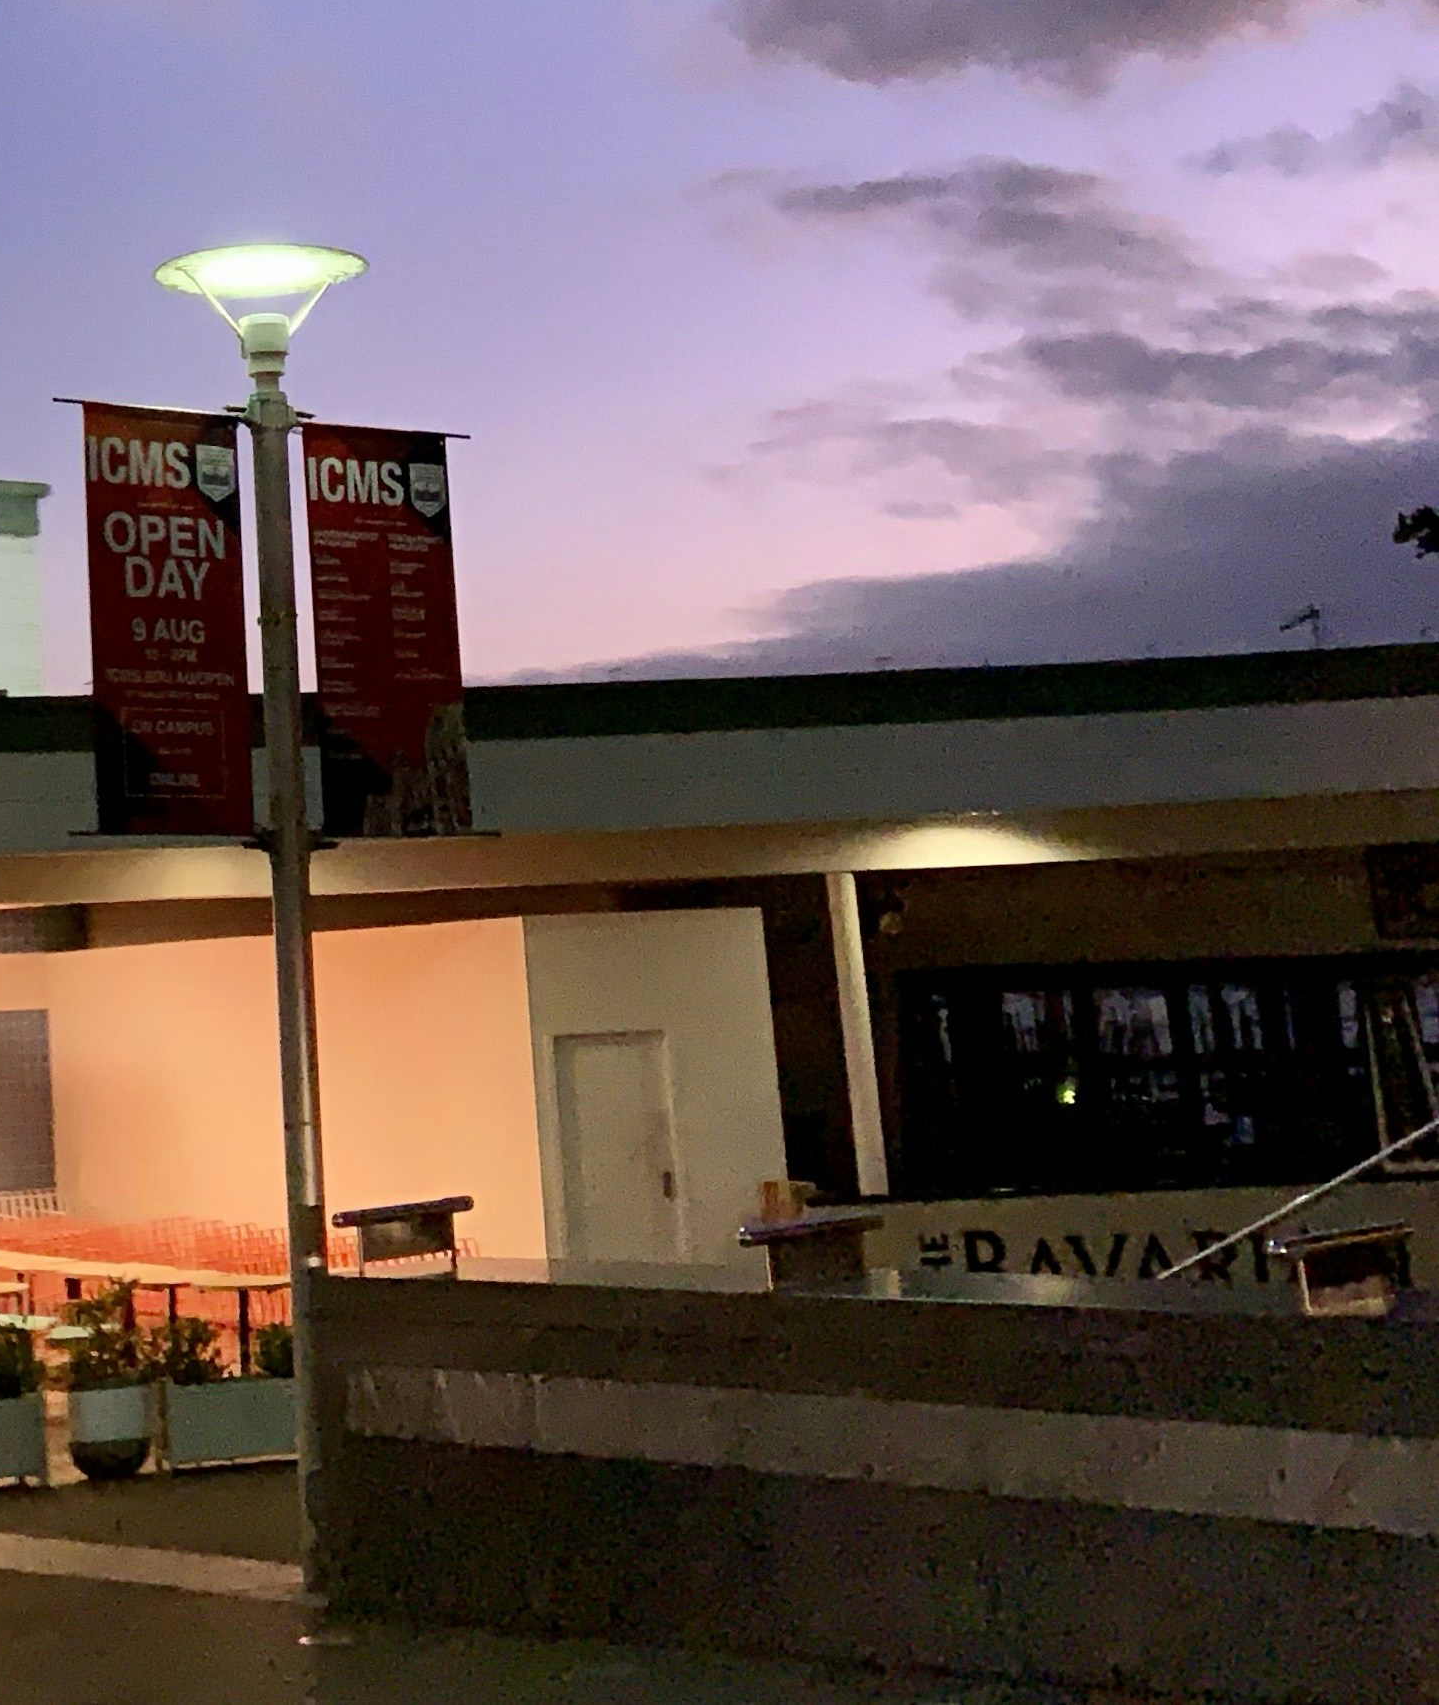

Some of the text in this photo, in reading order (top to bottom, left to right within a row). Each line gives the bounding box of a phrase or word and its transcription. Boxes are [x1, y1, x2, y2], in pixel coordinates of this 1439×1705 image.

[85, 436, 191, 489] ICMS
[307, 457, 404, 506] ICMS
[103, 511, 225, 559] OPEN
[124, 556, 210, 601] DAY
[132, 616, 205, 644] 9 AUG
